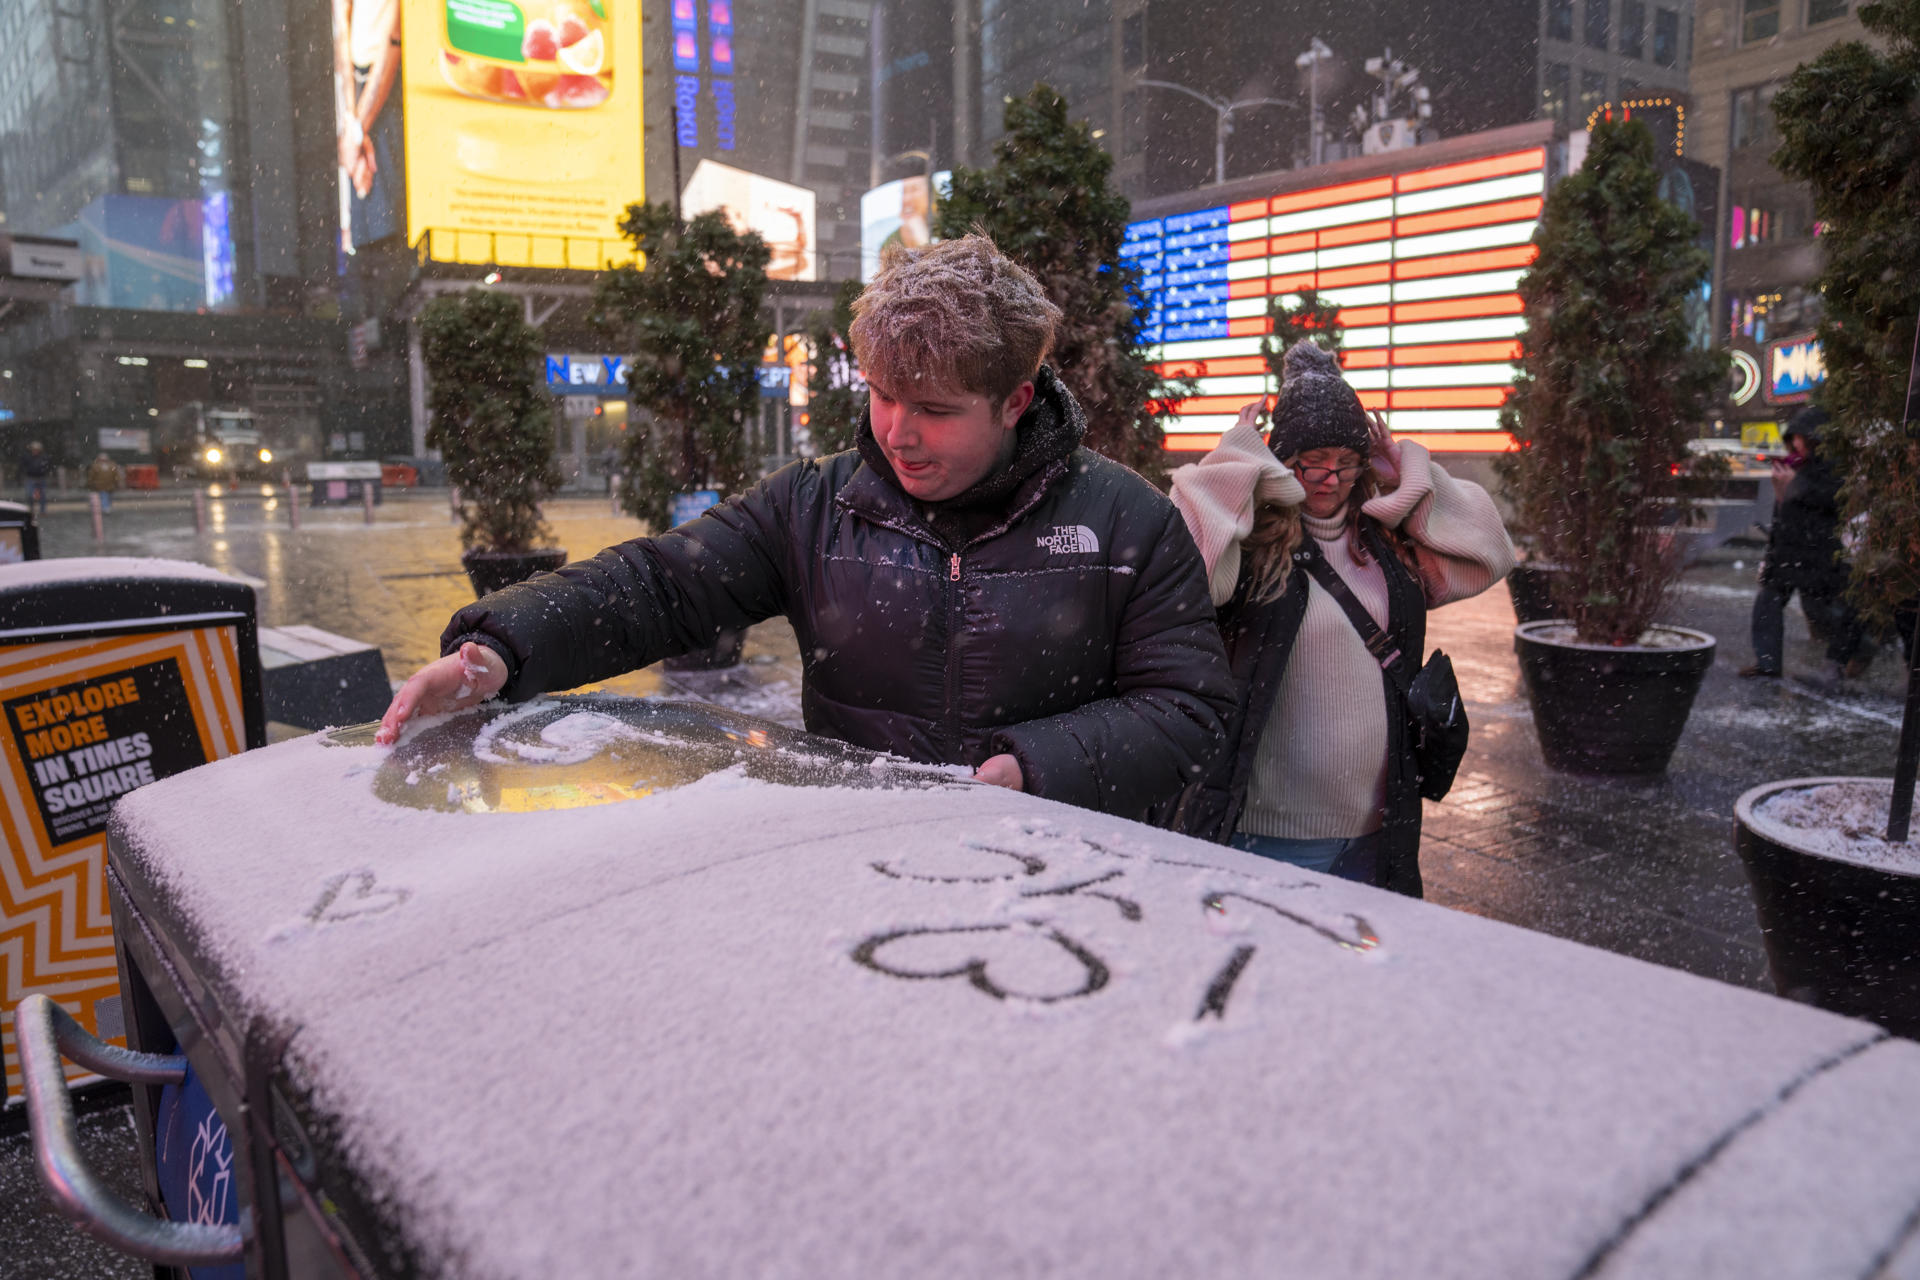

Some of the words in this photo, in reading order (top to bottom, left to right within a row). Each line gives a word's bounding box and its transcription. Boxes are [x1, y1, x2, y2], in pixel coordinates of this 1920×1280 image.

[675, 75, 699, 148] ROKU
[546, 355, 600, 384] NEW
[1036, 534, 1078, 547] NORTH
[1049, 544, 1079, 555] FACE
[1052, 525, 1077, 535] THE
[14, 676, 140, 731] EXPLORE
[24, 715, 109, 760] MORE
[34, 755, 70, 787] IN
[69, 732, 153, 776] TIMES
[44, 759, 156, 814] SQUARE
